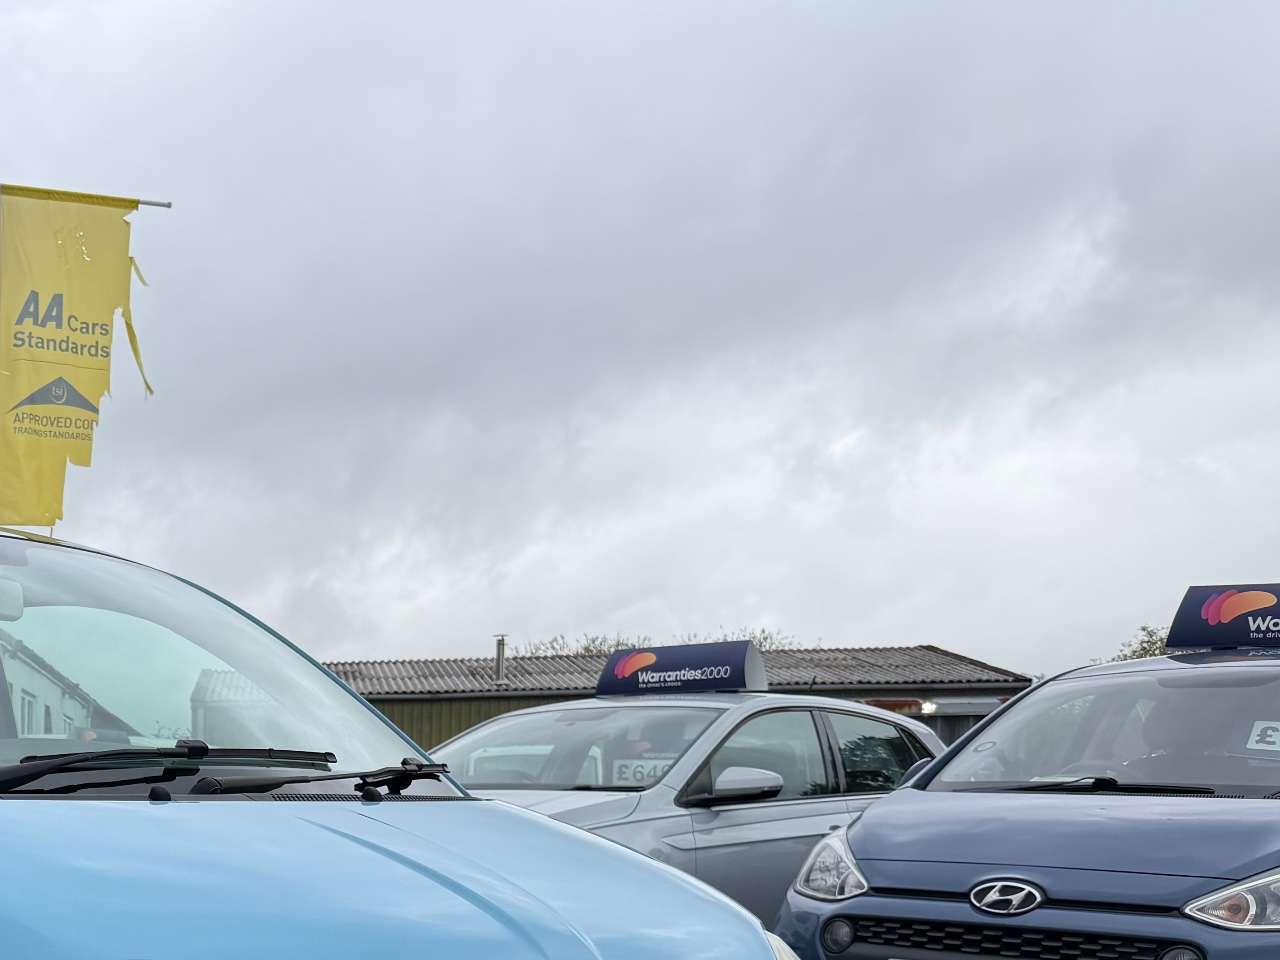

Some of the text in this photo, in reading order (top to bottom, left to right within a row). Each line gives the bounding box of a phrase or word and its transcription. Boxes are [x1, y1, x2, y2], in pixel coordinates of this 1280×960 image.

[15, 290, 110, 336] AA Cars
[13, 330, 111, 358] Standards
[13, 411, 72, 430] APPROVED
[638, 665, 731, 683] Warranties2000
